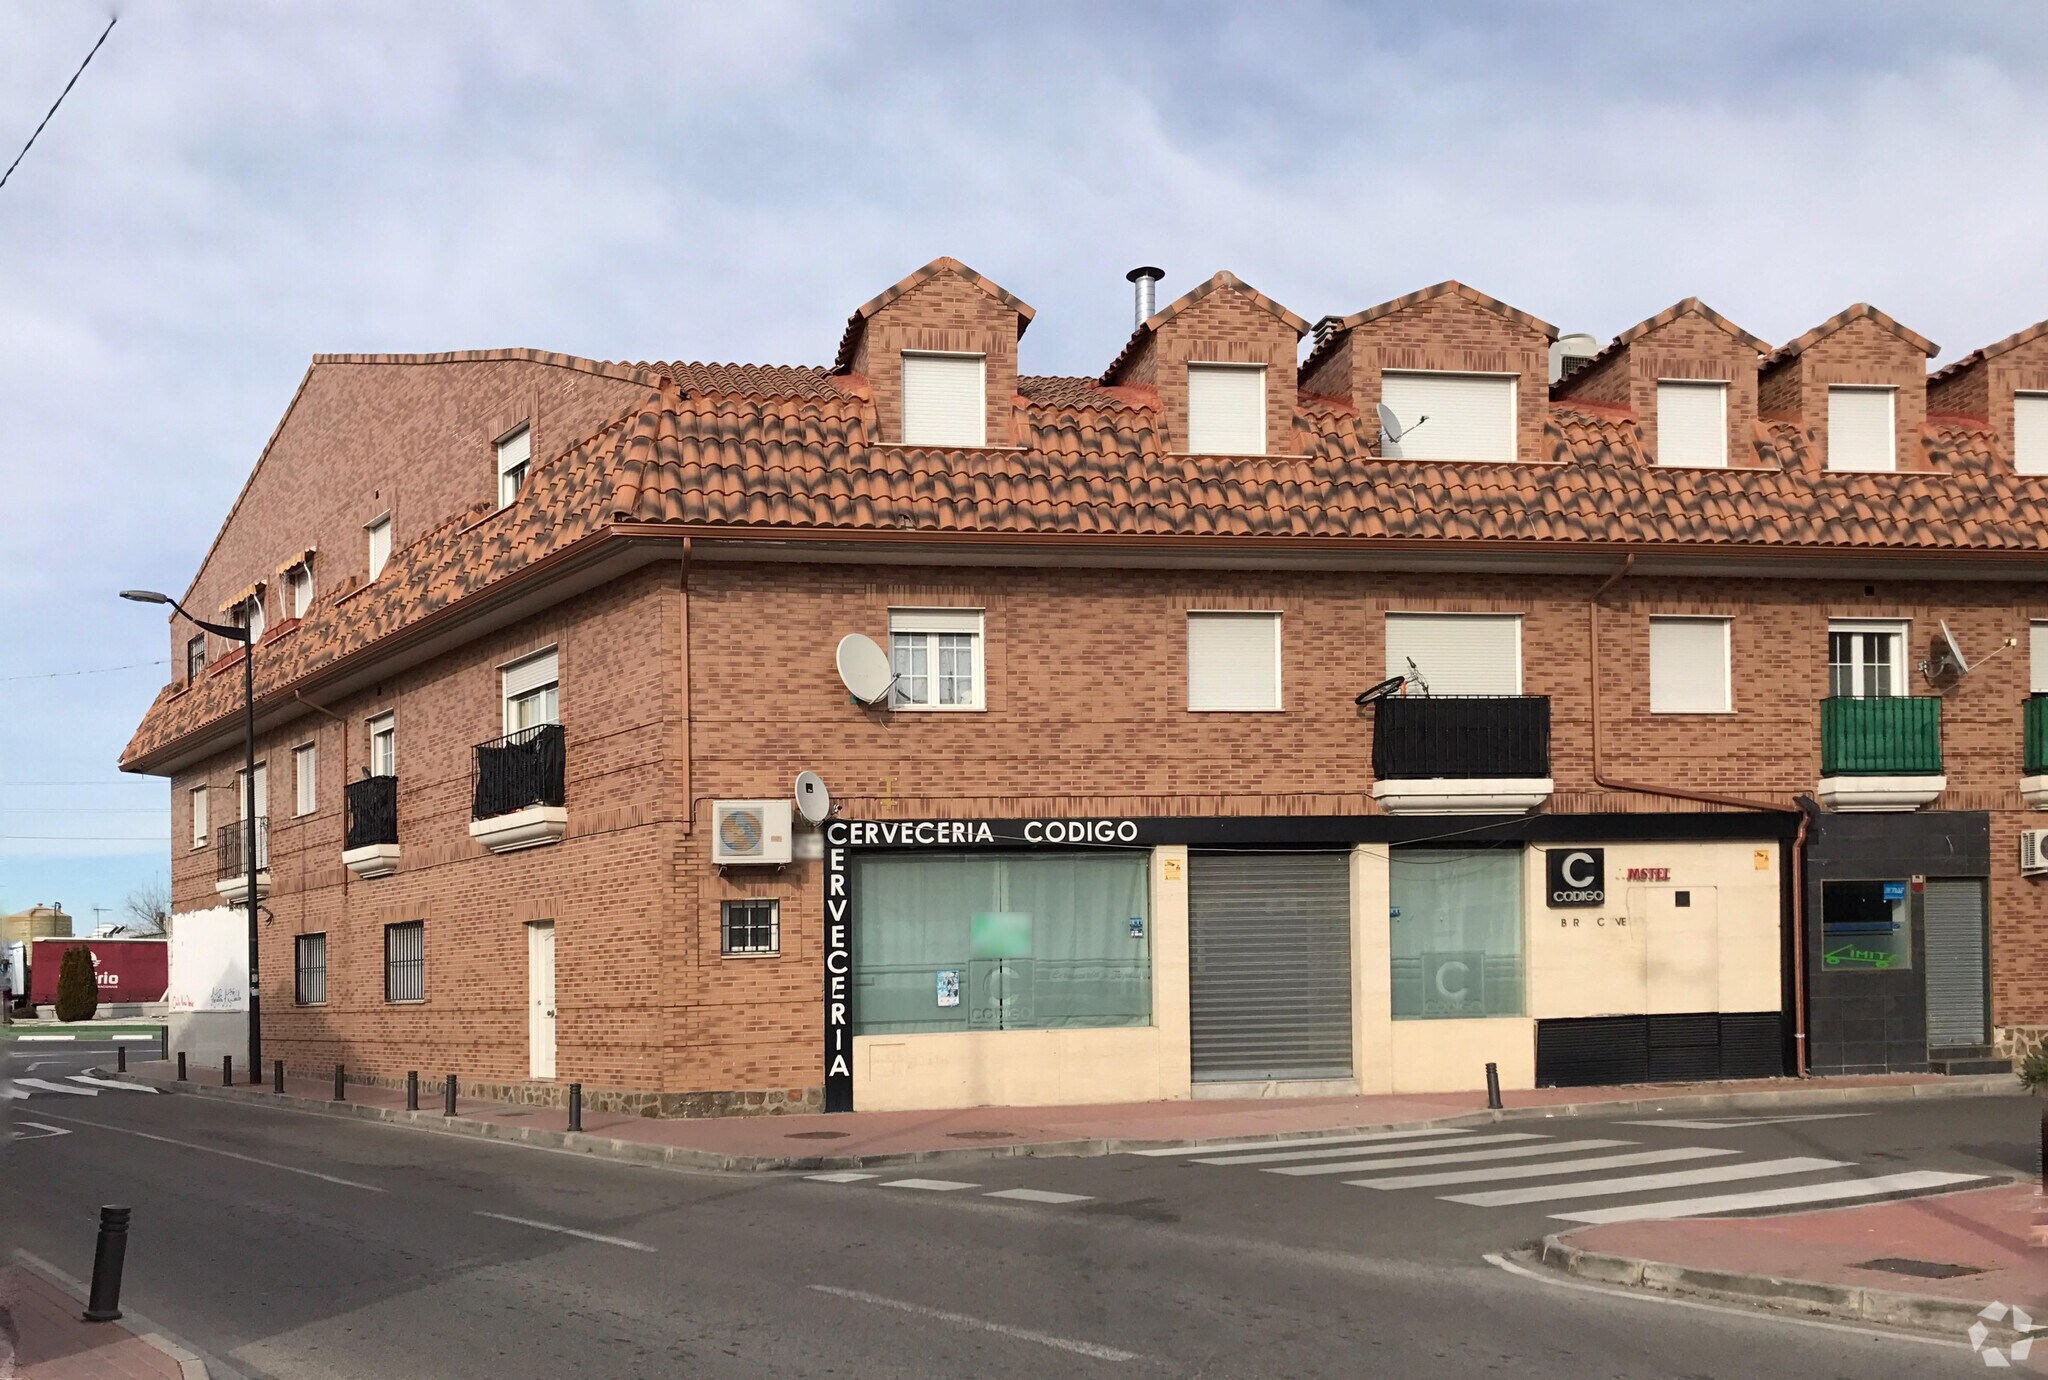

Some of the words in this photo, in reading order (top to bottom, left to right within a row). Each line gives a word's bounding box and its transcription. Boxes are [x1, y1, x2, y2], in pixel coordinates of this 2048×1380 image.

[827, 821, 994, 845] CERVECERIA
[1023, 820, 1138, 843] CODIGO
[1562, 852, 1595, 888] C
[1553, 890, 1604, 902] CODIGO
